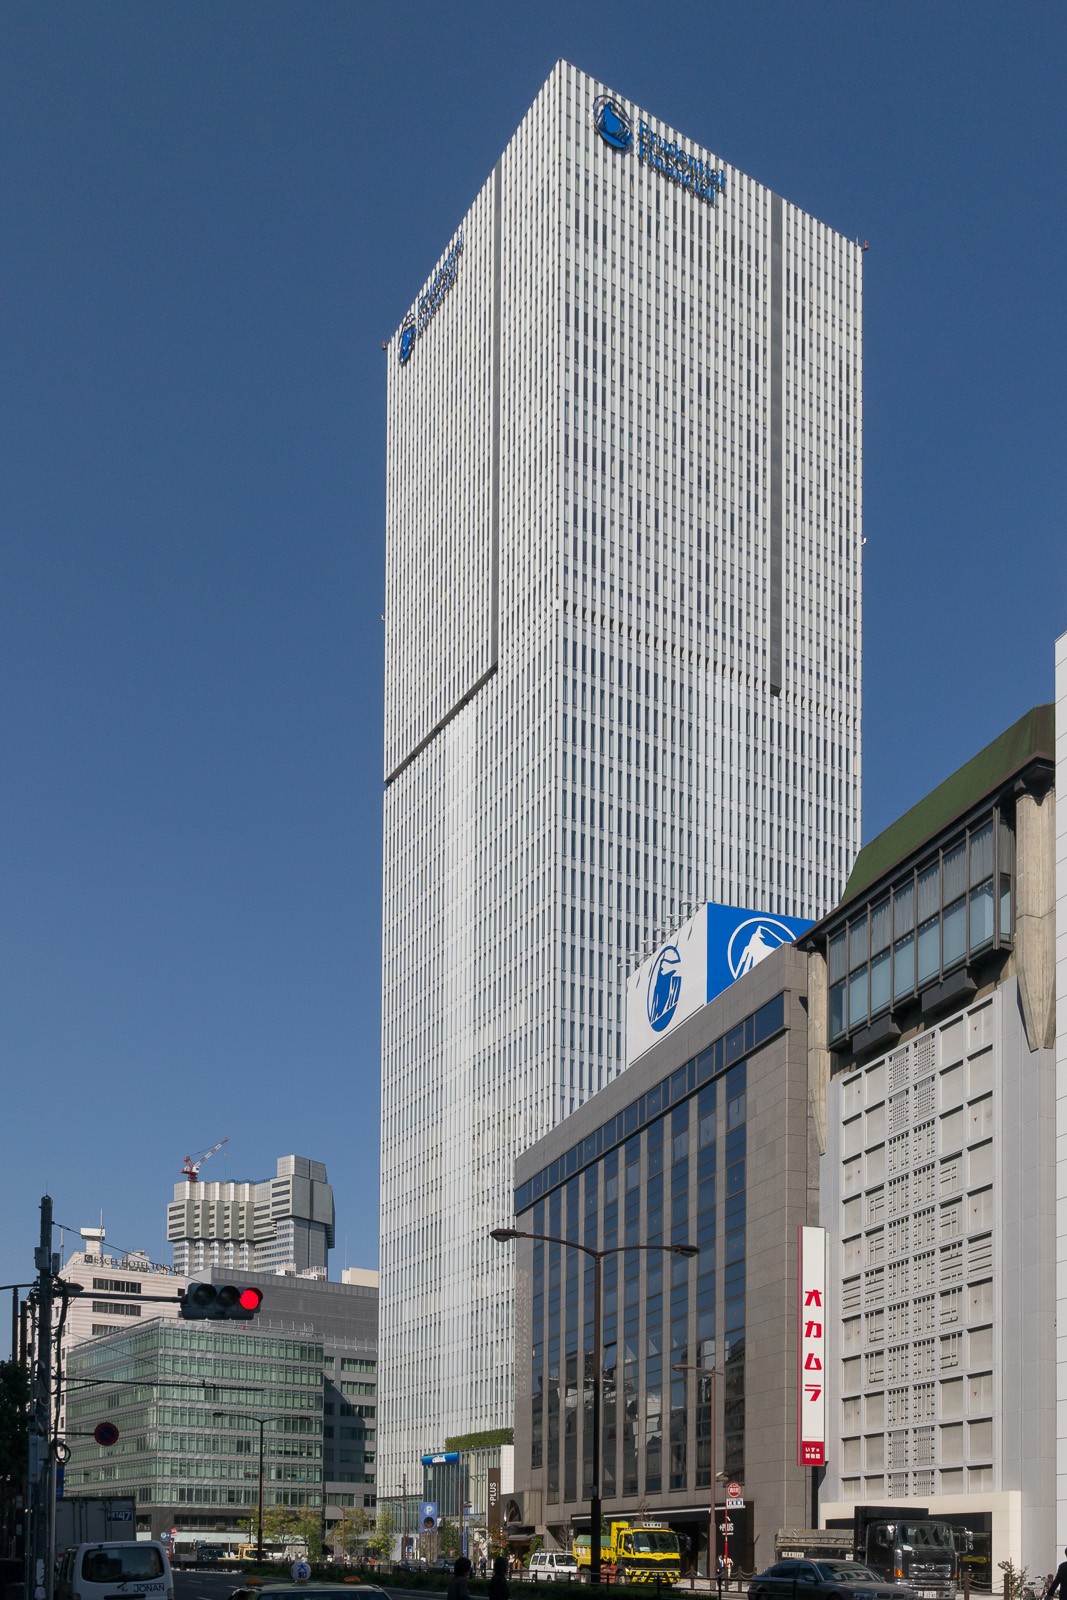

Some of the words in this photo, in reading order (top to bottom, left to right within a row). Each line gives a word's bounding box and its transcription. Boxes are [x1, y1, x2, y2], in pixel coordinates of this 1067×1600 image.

[94, 1256, 120, 1267] EXCEL
[121, 1258, 150, 1271] HOTEL
[804, 1289, 823, 1402] オカムラ
[425, 1505, 433, 1516] P
[133, 1583, 165, 1593] JONAN
